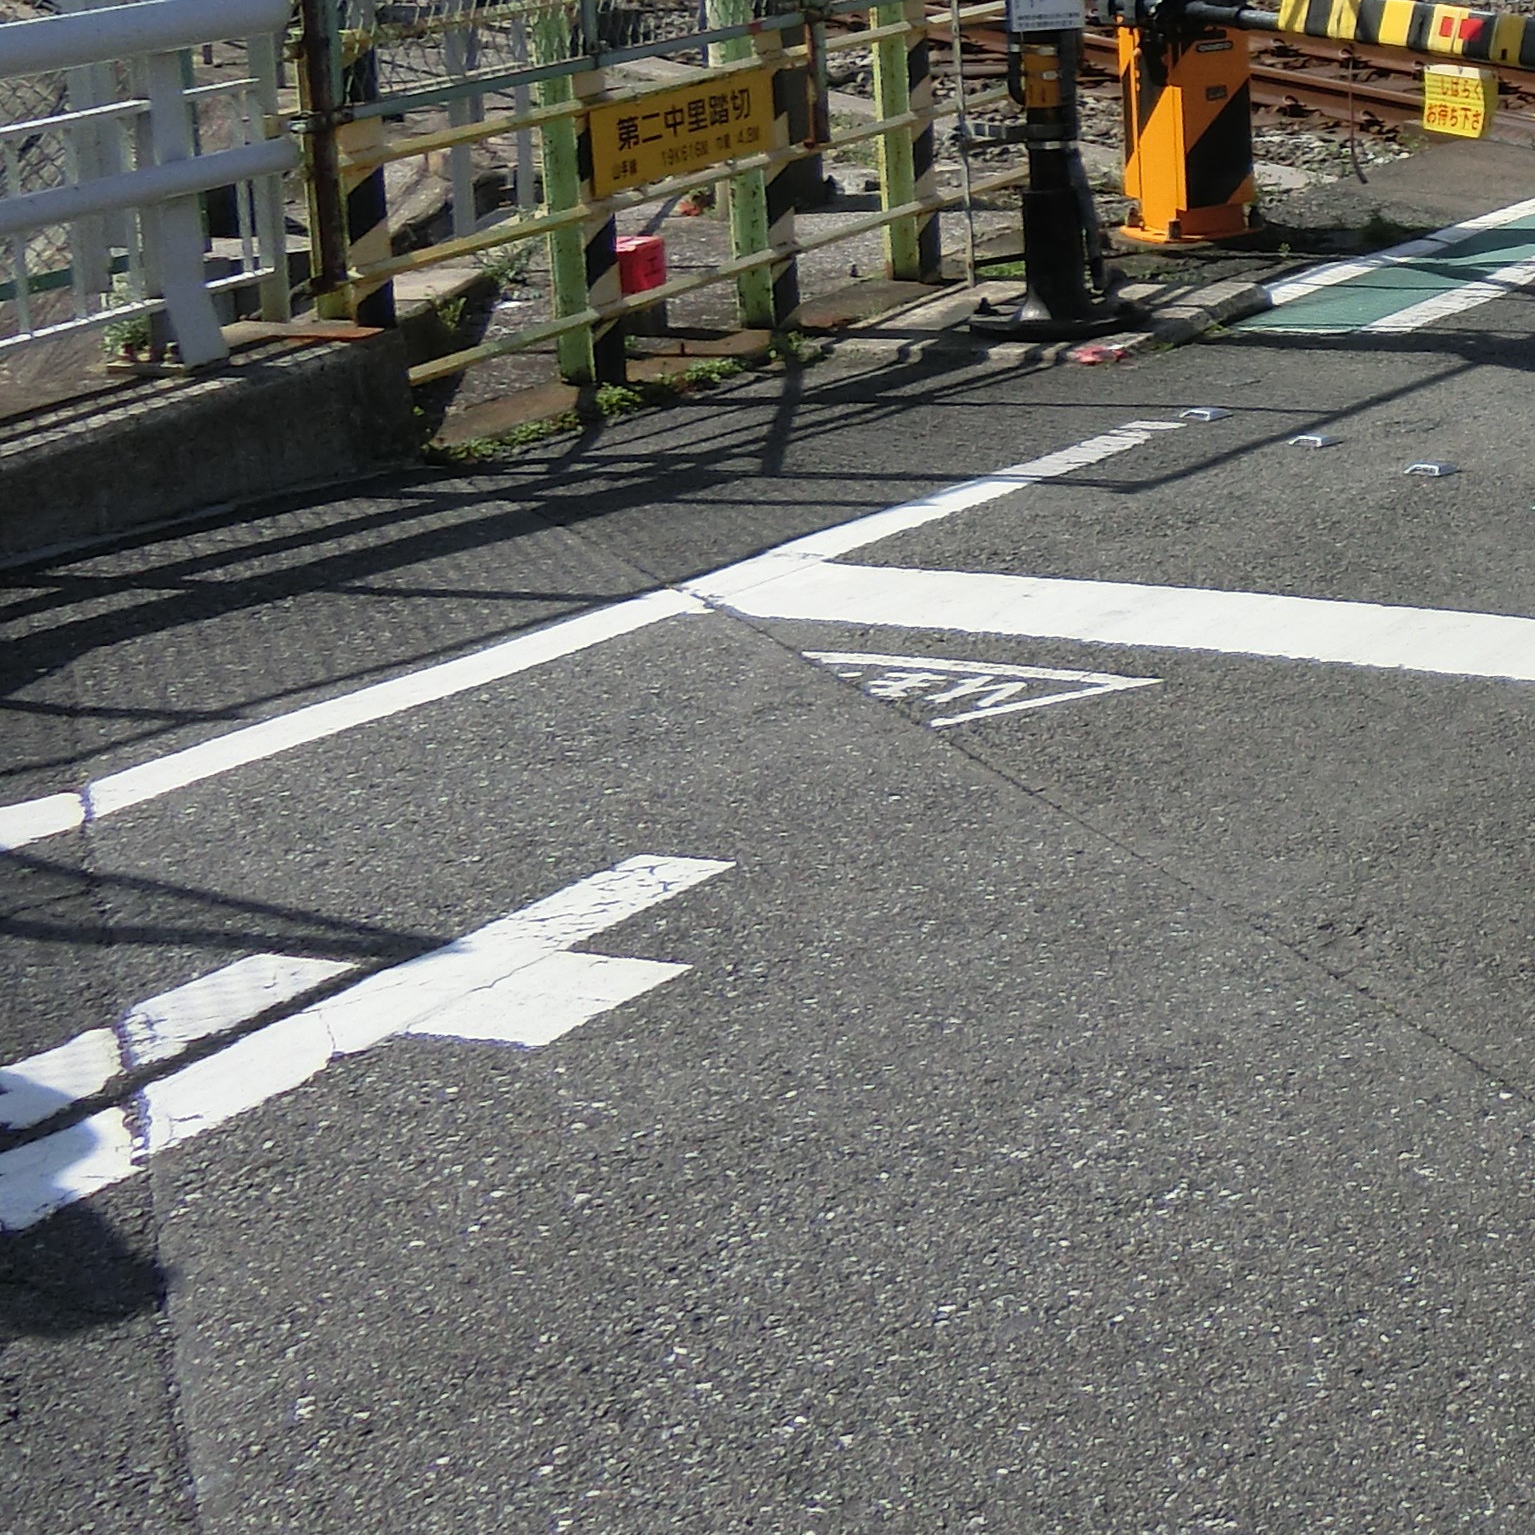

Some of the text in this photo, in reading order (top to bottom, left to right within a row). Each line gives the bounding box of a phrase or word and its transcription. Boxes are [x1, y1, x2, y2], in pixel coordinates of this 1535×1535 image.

[1440, 77, 1481, 101] しばらく
[615, 88, 751, 152] 第二中里踏切
